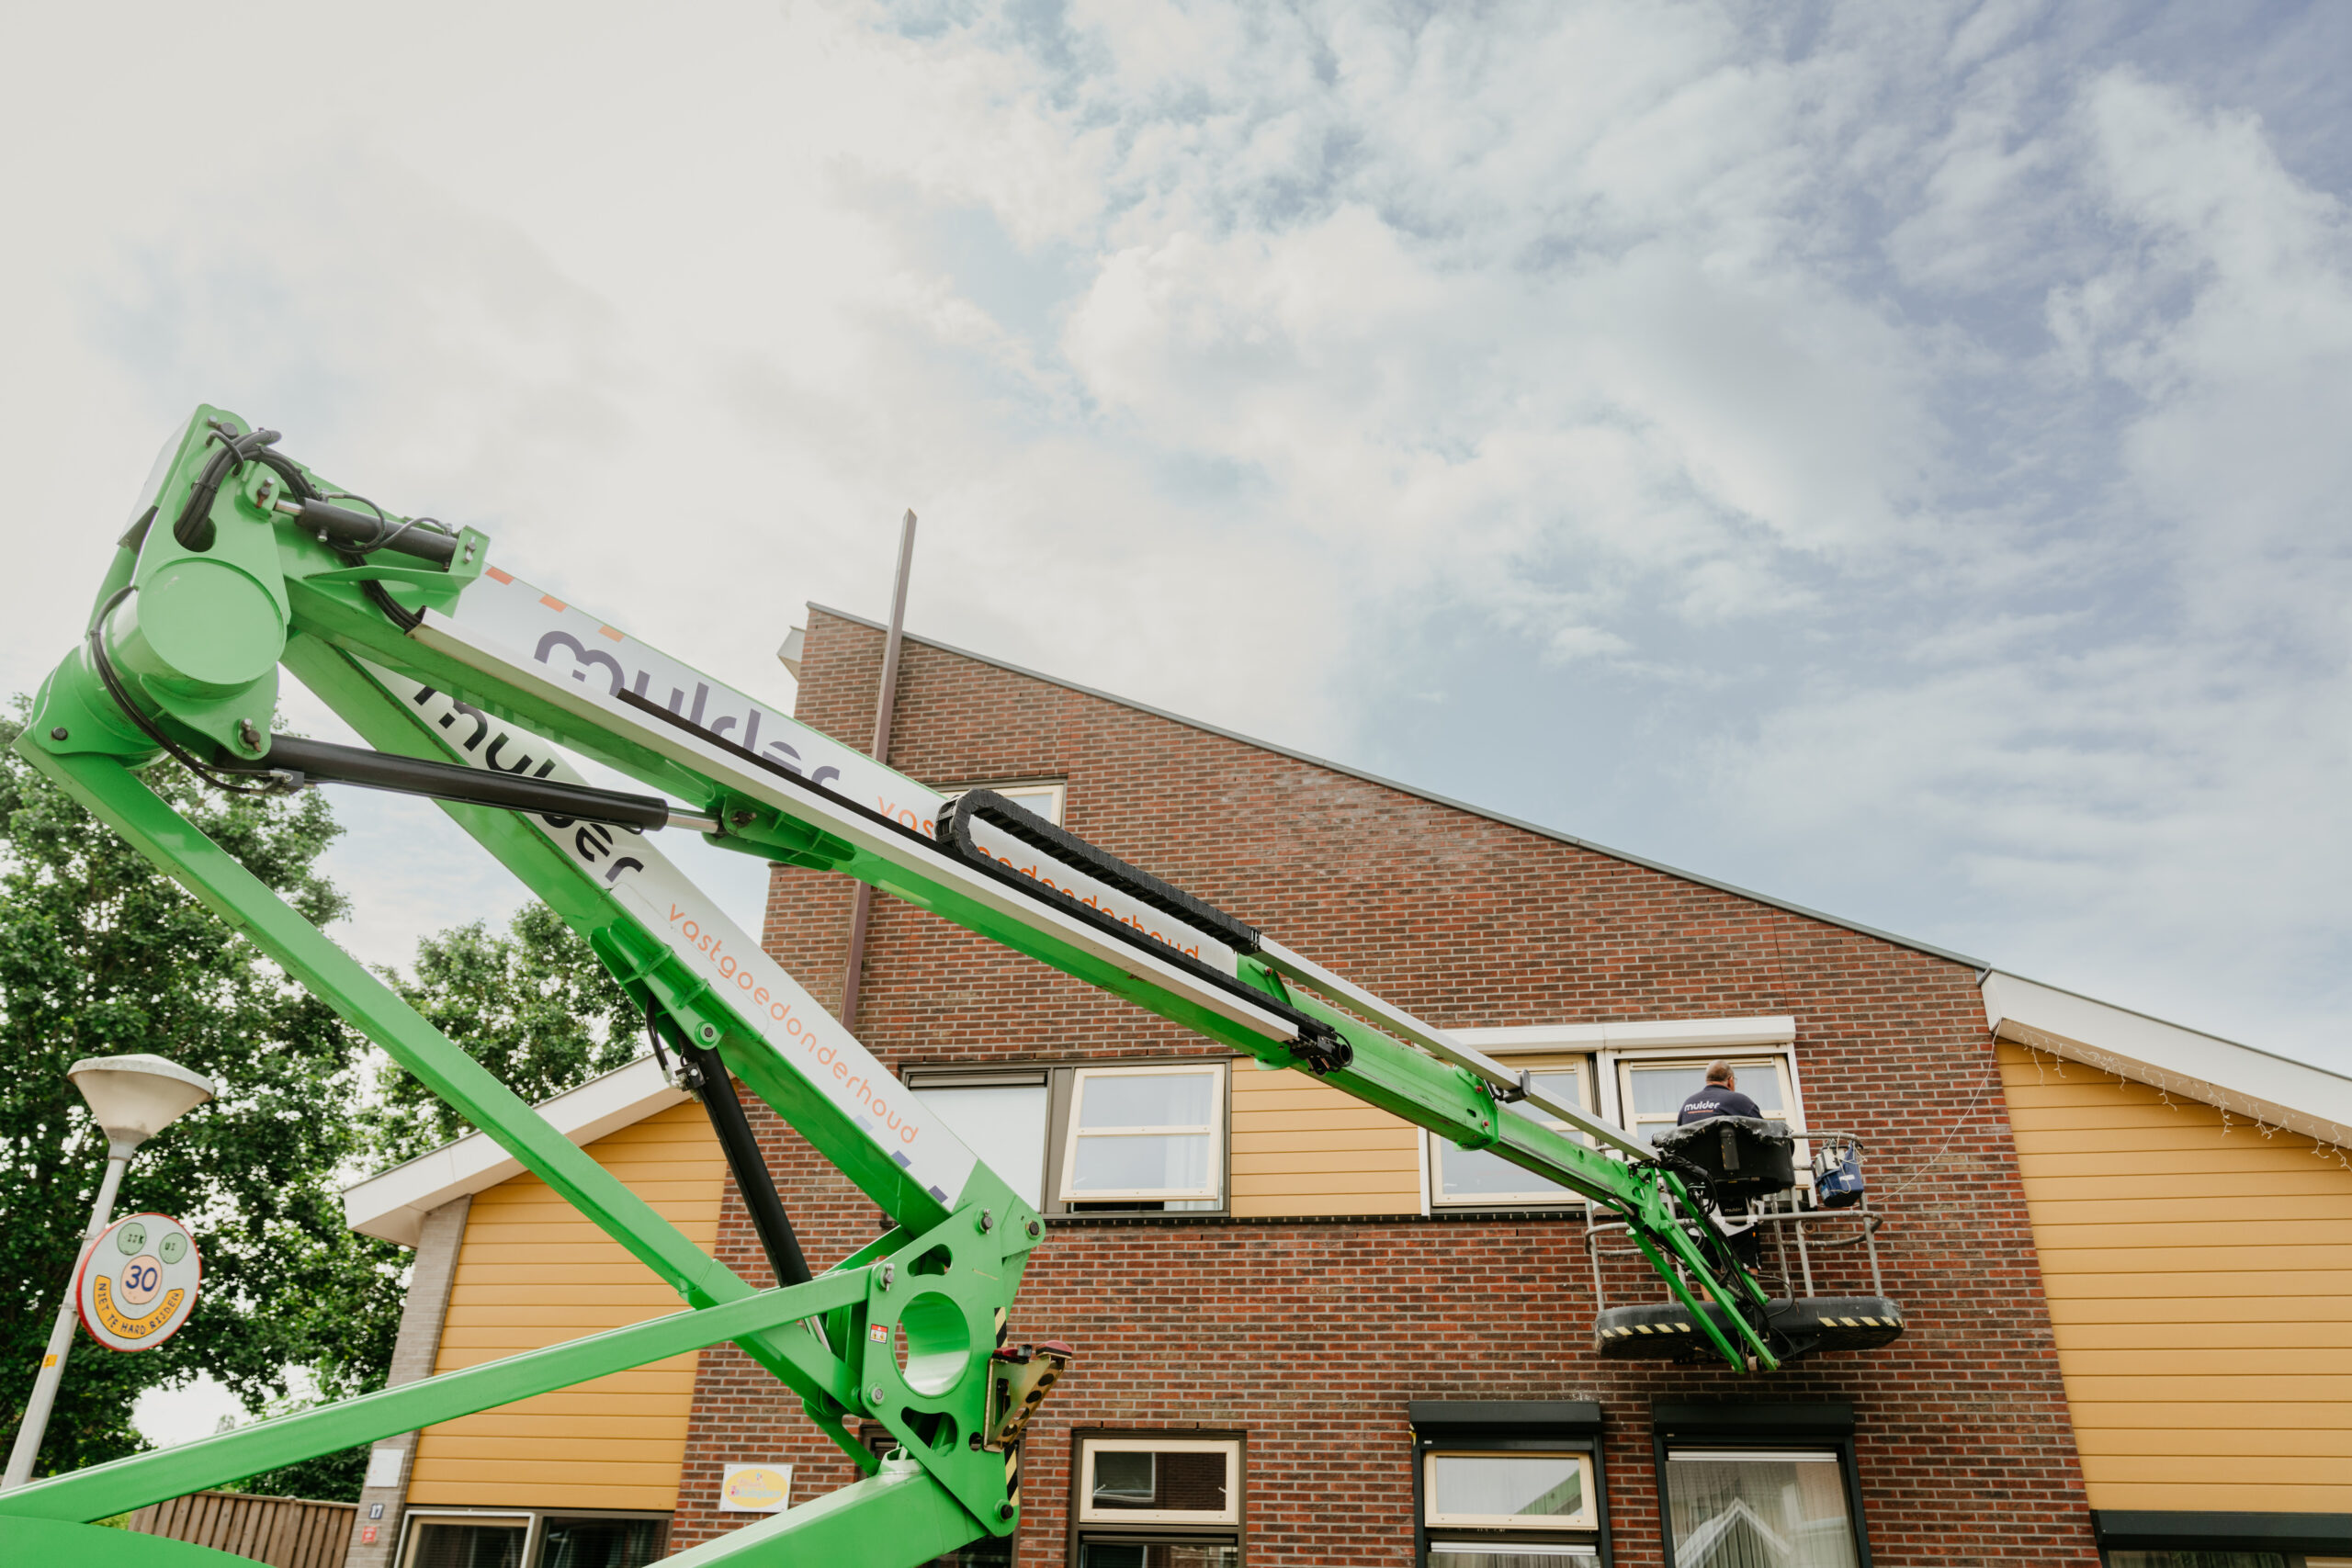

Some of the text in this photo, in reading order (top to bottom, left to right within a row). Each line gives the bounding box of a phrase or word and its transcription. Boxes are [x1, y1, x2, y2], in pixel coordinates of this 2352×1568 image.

[413, 686, 919, 1144] muer vastgoedonderhoud
[1684, 1100, 1720, 1111] mulder
[125, 1265, 158, 1292] 30
[98, 1282, 180, 1335] NIET TE HARD RIJDEN
[370, 1505, 383, 1518] 17
